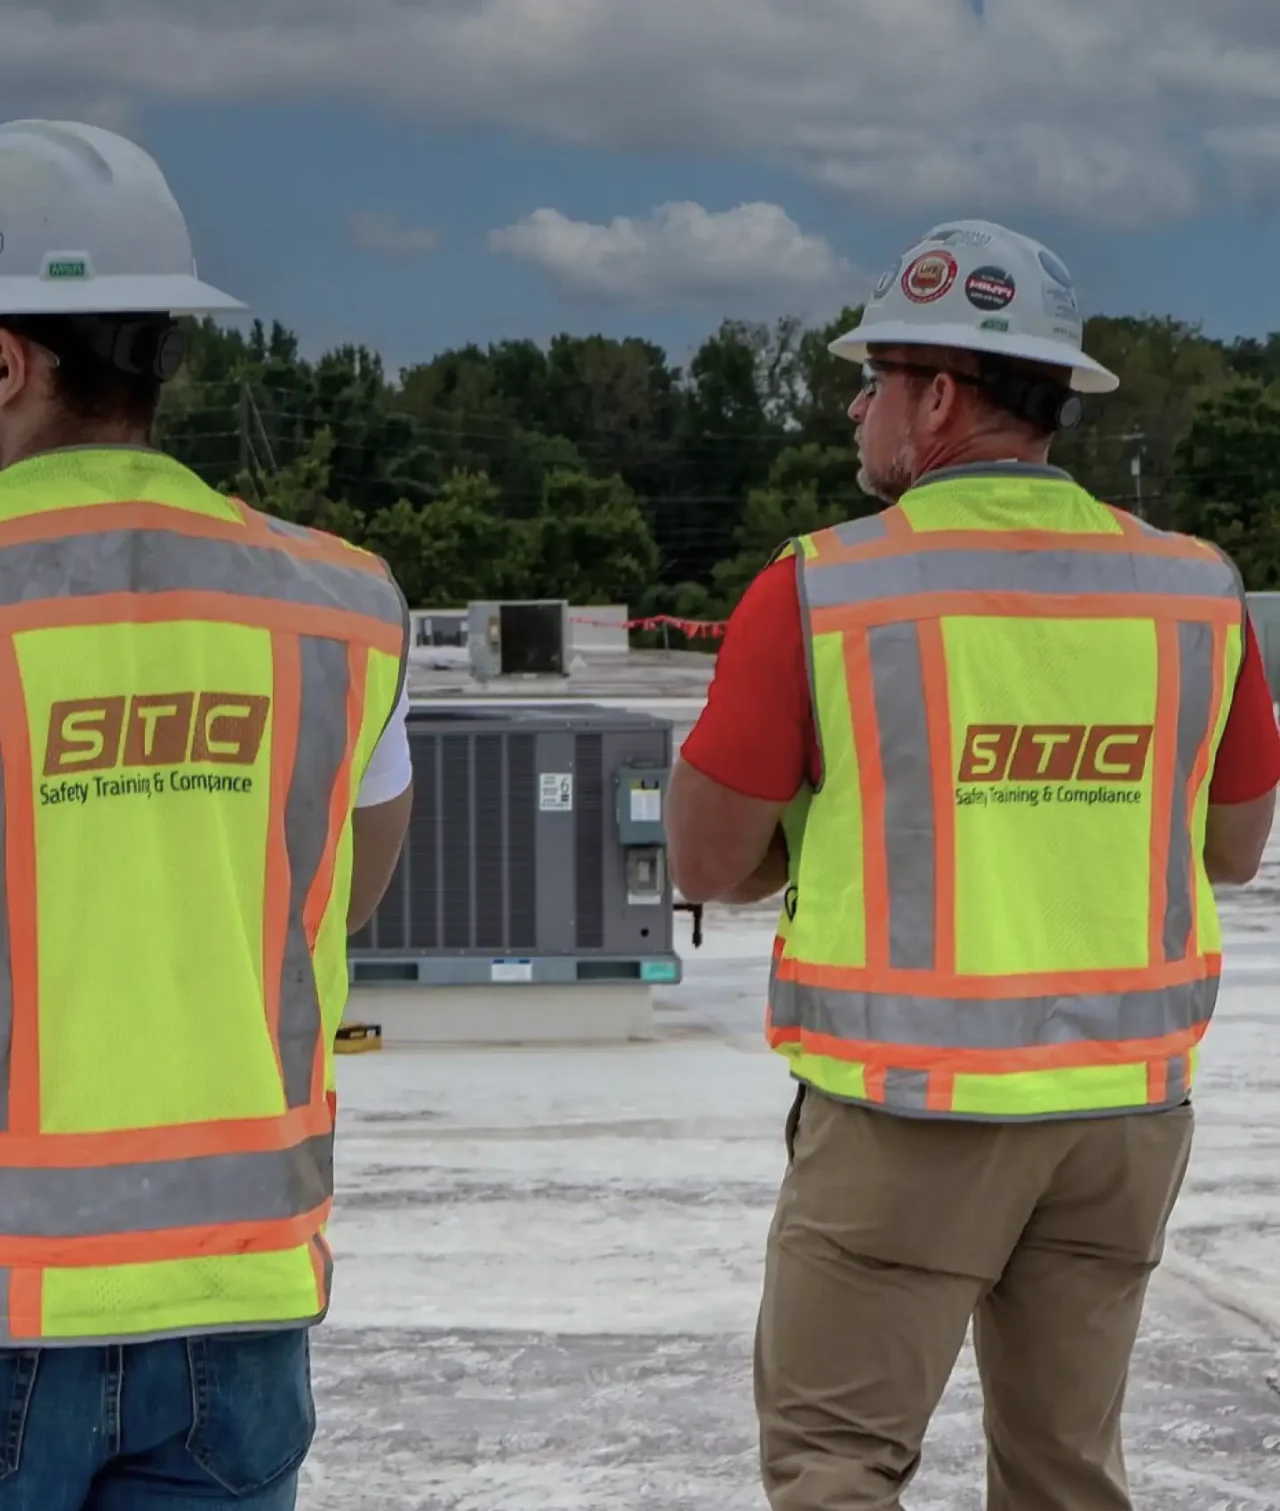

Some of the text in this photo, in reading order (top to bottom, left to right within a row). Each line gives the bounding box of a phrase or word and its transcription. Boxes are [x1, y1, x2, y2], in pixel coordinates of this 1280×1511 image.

[56, 702, 253, 766] STC
[968, 731, 1142, 777] STC
[40, 781, 89, 805] Safety
[154, 772, 164, 793] &
[1043, 786, 1053, 802] &
[1057, 786, 1141, 806] Compliance
